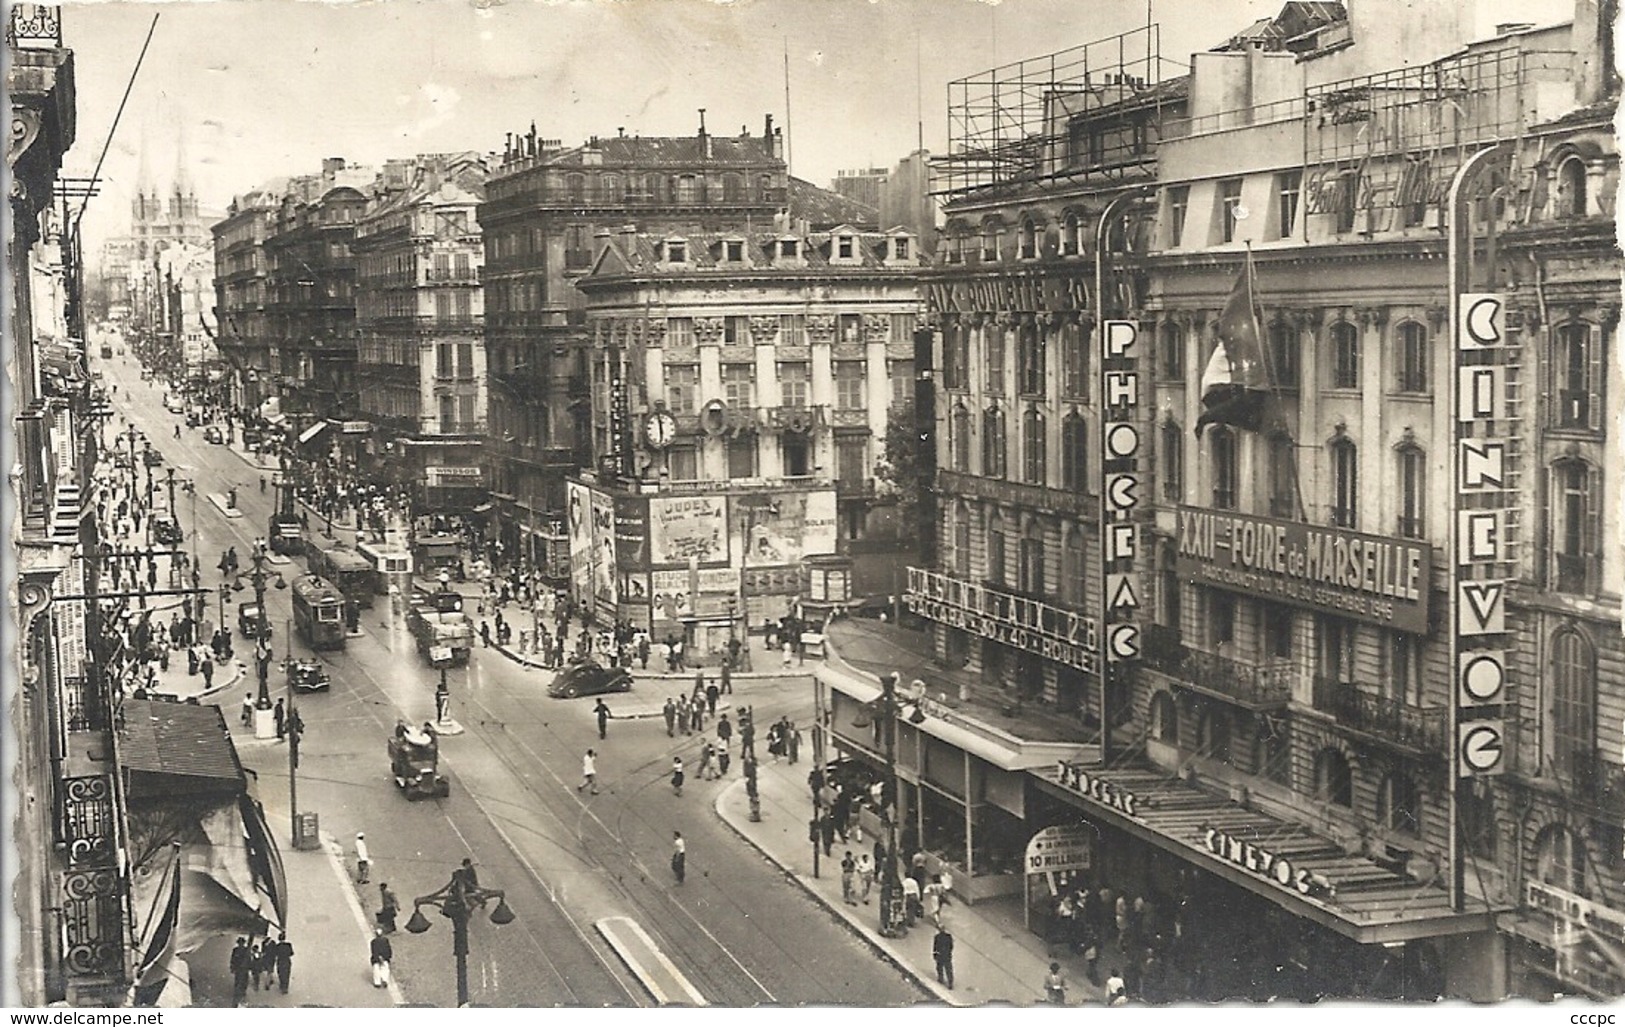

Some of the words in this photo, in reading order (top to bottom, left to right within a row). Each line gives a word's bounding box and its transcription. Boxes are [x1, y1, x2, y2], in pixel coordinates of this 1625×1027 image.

[665, 500, 711, 514] JUDEX
[1105, 321, 1141, 661] PHOCEAC
[1232, 519, 1286, 573] FOIRE
[1287, 543, 1304, 577] de
[1306, 531, 1421, 601] MARSEILLE
[1460, 294, 1504, 776] CINEVOG
[906, 566, 984, 615] CASINO
[1008, 594, 1044, 633] AIX
[909, 600, 966, 630] BACCARA
[980, 618, 997, 639] 30
[1010, 628, 1028, 649] 40
[1315, 587, 1366, 615] SEPTEMBRE
[1058, 759, 1135, 816] PHOCEAC
[1029, 856, 1042, 868] 10
[1206, 827, 1311, 894] CINEVOG
